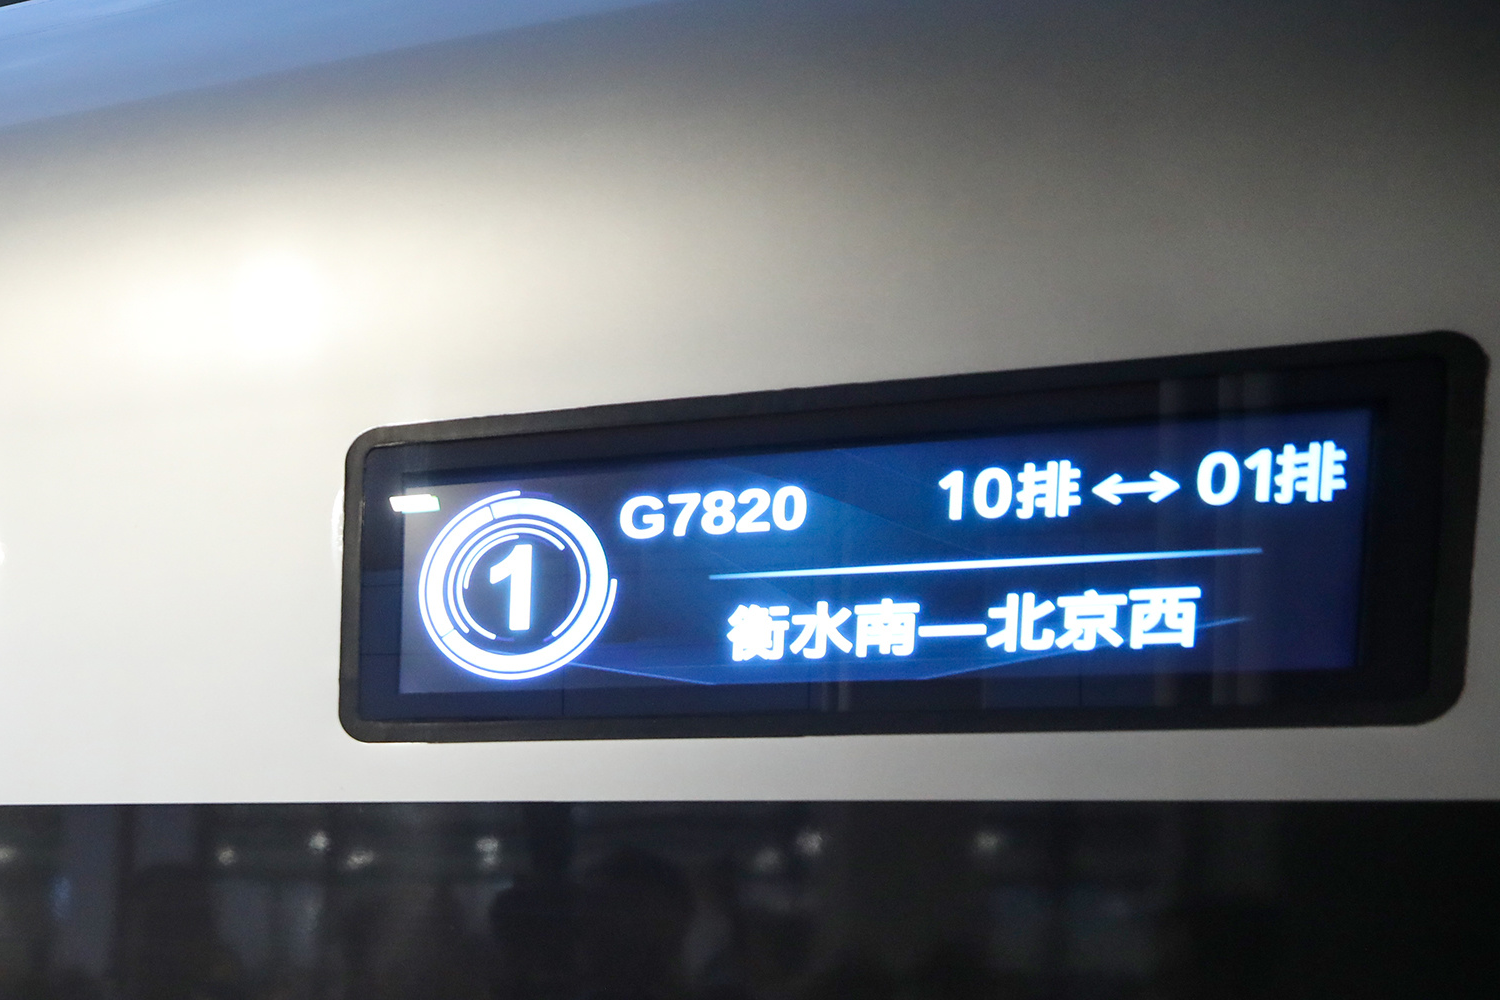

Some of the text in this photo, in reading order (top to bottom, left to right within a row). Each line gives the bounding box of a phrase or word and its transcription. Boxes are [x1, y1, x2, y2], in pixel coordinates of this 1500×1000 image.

[618, 484, 808, 539] G7820
[937, 440, 1347, 522] 10排 01排
[487, 541, 533, 632] 1
